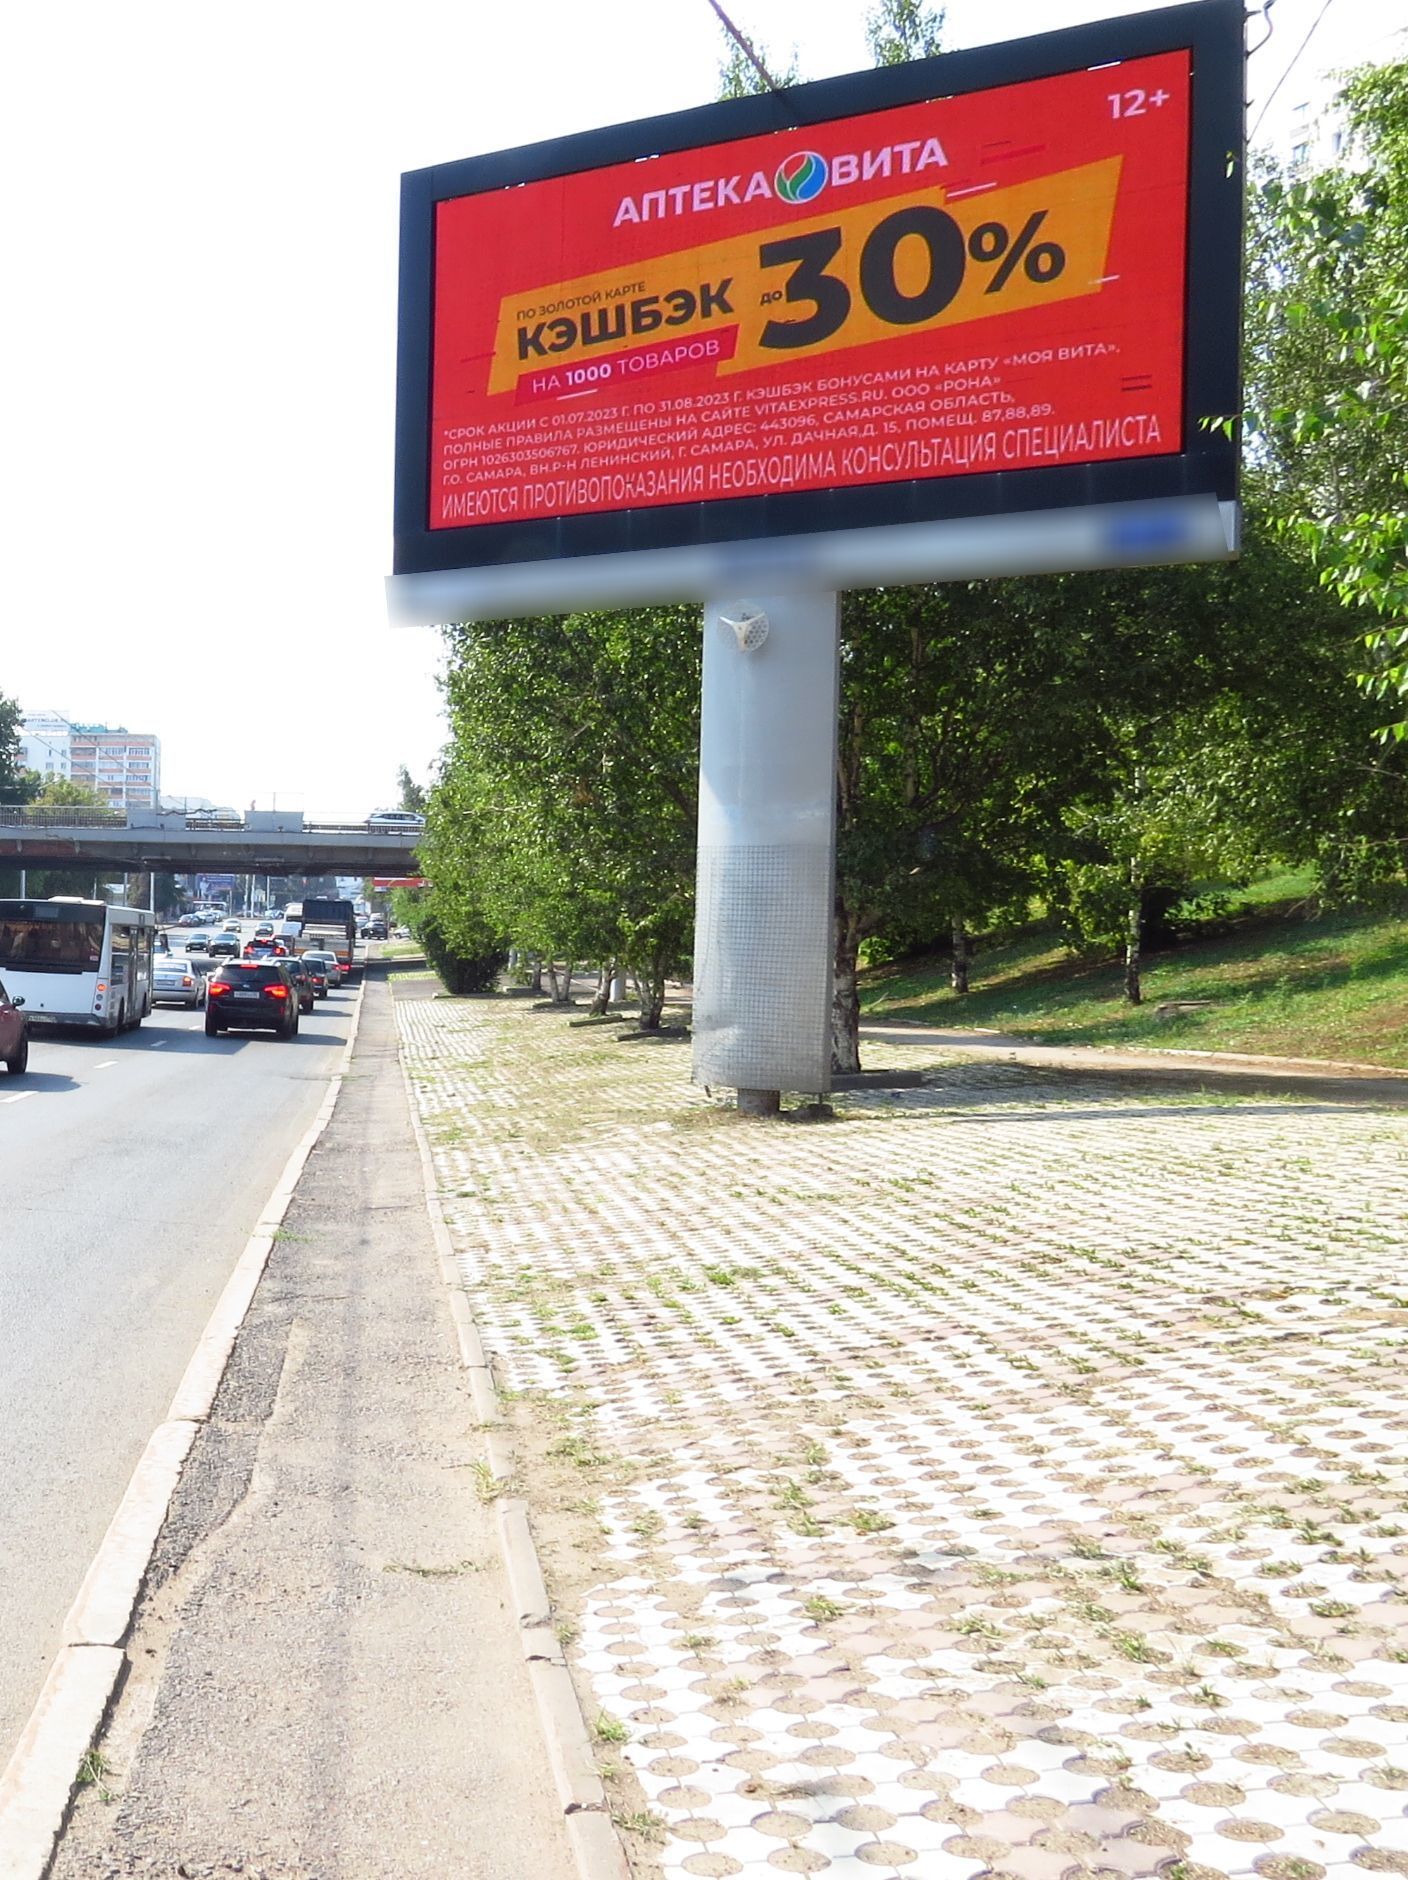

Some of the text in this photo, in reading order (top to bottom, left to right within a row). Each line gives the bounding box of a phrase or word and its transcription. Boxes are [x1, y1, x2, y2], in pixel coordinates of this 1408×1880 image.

[1107, 88, 1170, 119] 12+
[612, 136, 949, 227] АПТЕКА ВИТА
[516, 281, 646, 321] ПО ЗОЛОТОЙ КАРТЕ
[518, 277, 734, 360] КЭШБЭК
[758, 204, 1066, 349] 30%
[488, 418, 536, 435] АКЦИИ
[540, 416, 549, 427] С
[552, 407, 618, 426] 01.07.2023
[622, 406, 631, 417] Г.
[633, 403, 656, 416] ПО
[659, 393, 730, 412] 31.08.2023
[733, 391, 743, 402] Г.
[746, 382, 813, 401] КЭШБЭК
[817, 368, 910, 390] БОНУСАМИ
[916, 365, 940, 378] НА
[945, 357, 999, 375] КАРТУ
[1003, 349, 1053, 366] «МОЯ
[1058, 343, 1120, 361] ВИТА».
[532, 339, 720, 393] НА 1000 ТОВАРОВ
[443, 375, 1001, 455] ПОЛНЫЕ ПРАВИЛА РАЗМЕЩЕНЫ НА САЙТЕ VITAEXPRESS.RU. ООО «РОНА»
[443, 457, 479, 471] ОГРН
[583, 428, 698, 453] ЮРИДИЧЕСКИЙ
[702, 421, 757, 439] АДРЕС:
[760, 414, 820, 432] 443096,
[824, 400, 926, 424] САМАРСКАЯ
[930, 391, 1015, 411] ОБЛАСТЬ,
[466, 465, 527, 482] САМАРА,
[530, 460, 577, 474] ВН.Р-Н
[580, 447, 675, 470] ЛЕНИНСКИЙ,
[677, 446, 687, 458] Г.
[690, 438, 761, 457] САМАРА,
[763, 436, 788, 448] УЛ.
[883, 421, 902, 434] 15,
[906, 411, 976, 431] ПОМЕЩ.
[982, 403, 1055, 423] 87,88,89.
[442, 414, 1161, 519] ИМЕЮТСЯ ПРОТИВОПОКАЗАНИЯ НЕОБХОДИМА КОНСУЛЬТАЦИЯ СПЕЦИАЛИСТА
